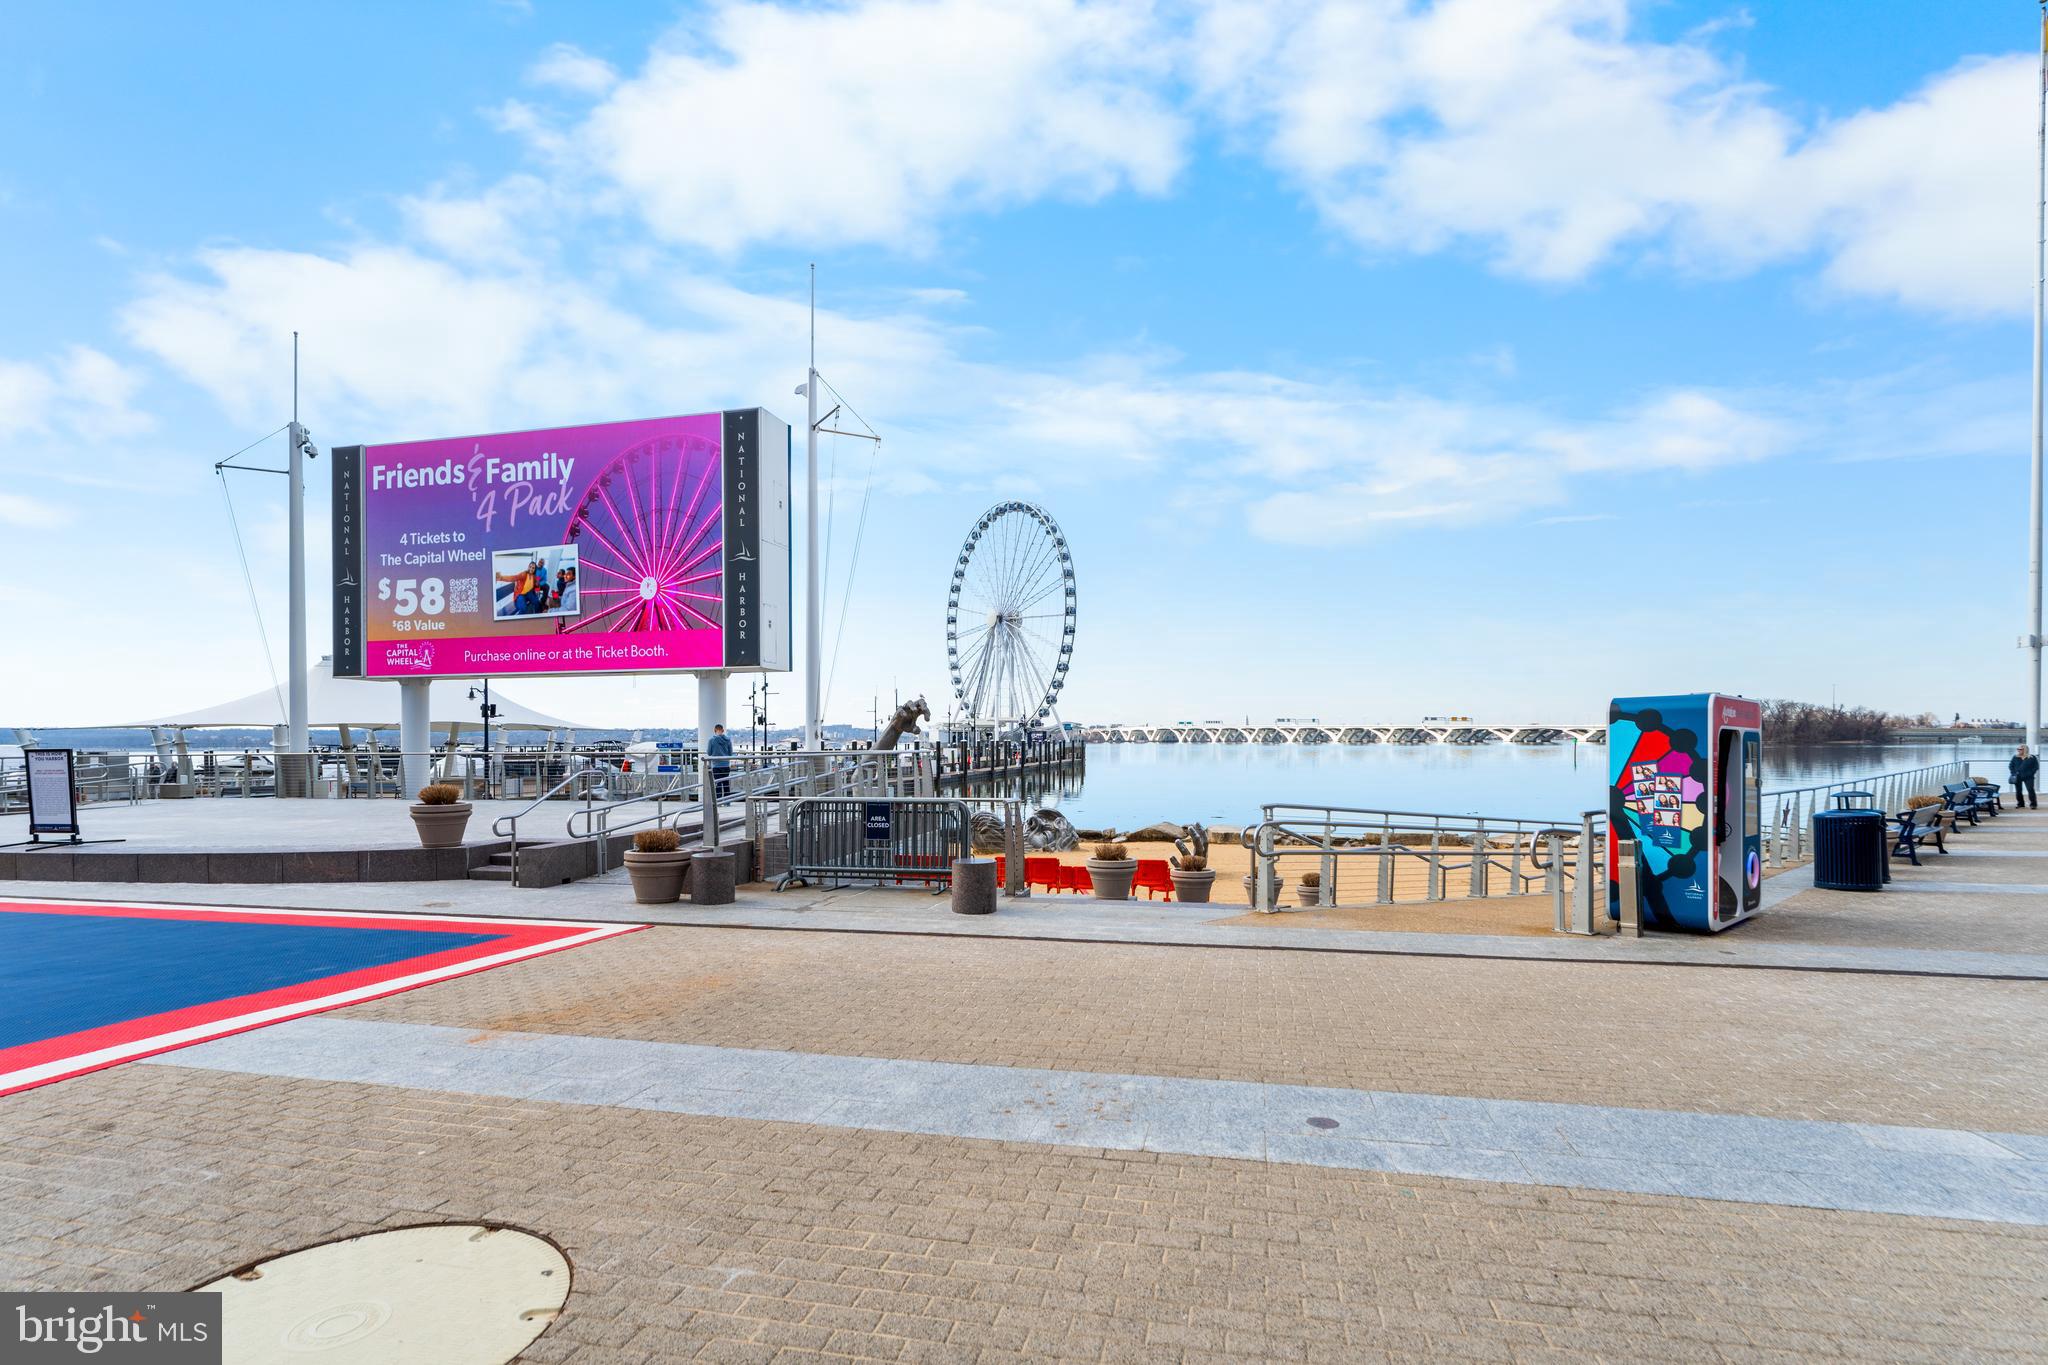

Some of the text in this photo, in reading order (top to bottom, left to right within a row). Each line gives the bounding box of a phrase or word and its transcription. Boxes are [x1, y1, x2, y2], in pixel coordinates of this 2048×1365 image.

[372, 459, 465, 490] Friends
[486, 452, 575, 485] Family
[476, 481, 574, 533] 4 Pack
[399, 531, 466, 545] 4 Tickets to
[737, 432, 747, 640] NATIONAL HARBOR
[380, 548, 486, 567] The Capital Wheel
[378, 577, 446, 616] $58
[343, 596, 351, 656] HARBOR
[392, 619, 445, 631] $68 Value
[386, 649, 418, 657] CAPITAL
[386, 658, 414, 666] WHEEL
[464, 644, 669, 662] Purchase online or at the Ticket Booth.
